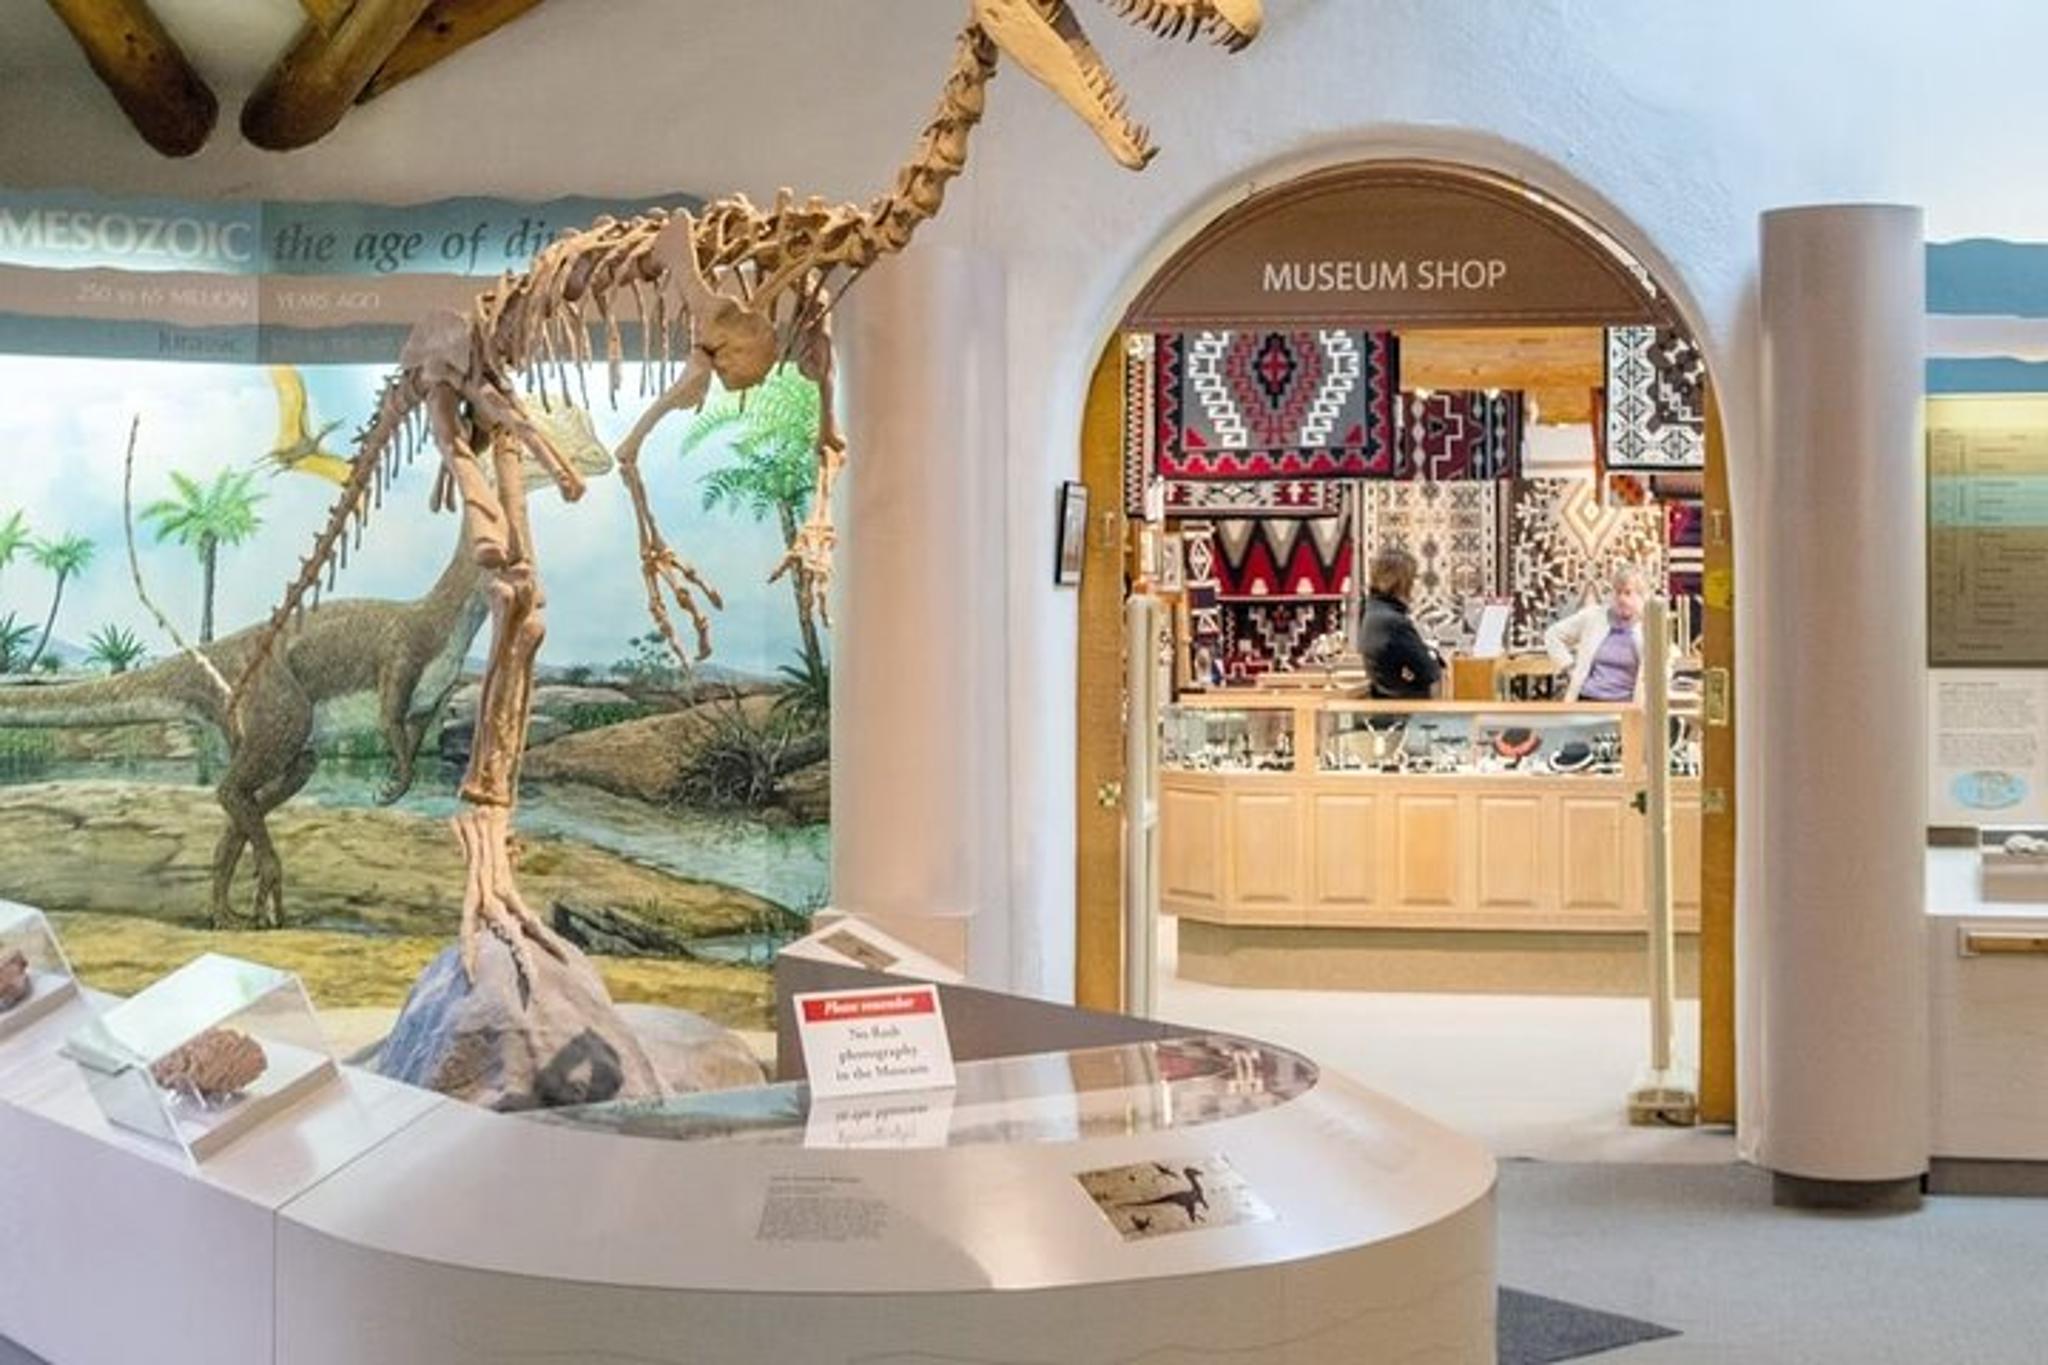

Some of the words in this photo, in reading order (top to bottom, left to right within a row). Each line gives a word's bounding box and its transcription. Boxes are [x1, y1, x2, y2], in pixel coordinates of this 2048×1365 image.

[0, 208, 251, 262] MESOZOIC
[274, 222, 336, 262] the
[354, 231, 423, 273] age
[440, 222, 489, 275] of
[1262, 261, 1408, 292] MUSEUM
[1417, 260, 1506, 290] SHOP
[838, 1045, 918, 1064] photography
